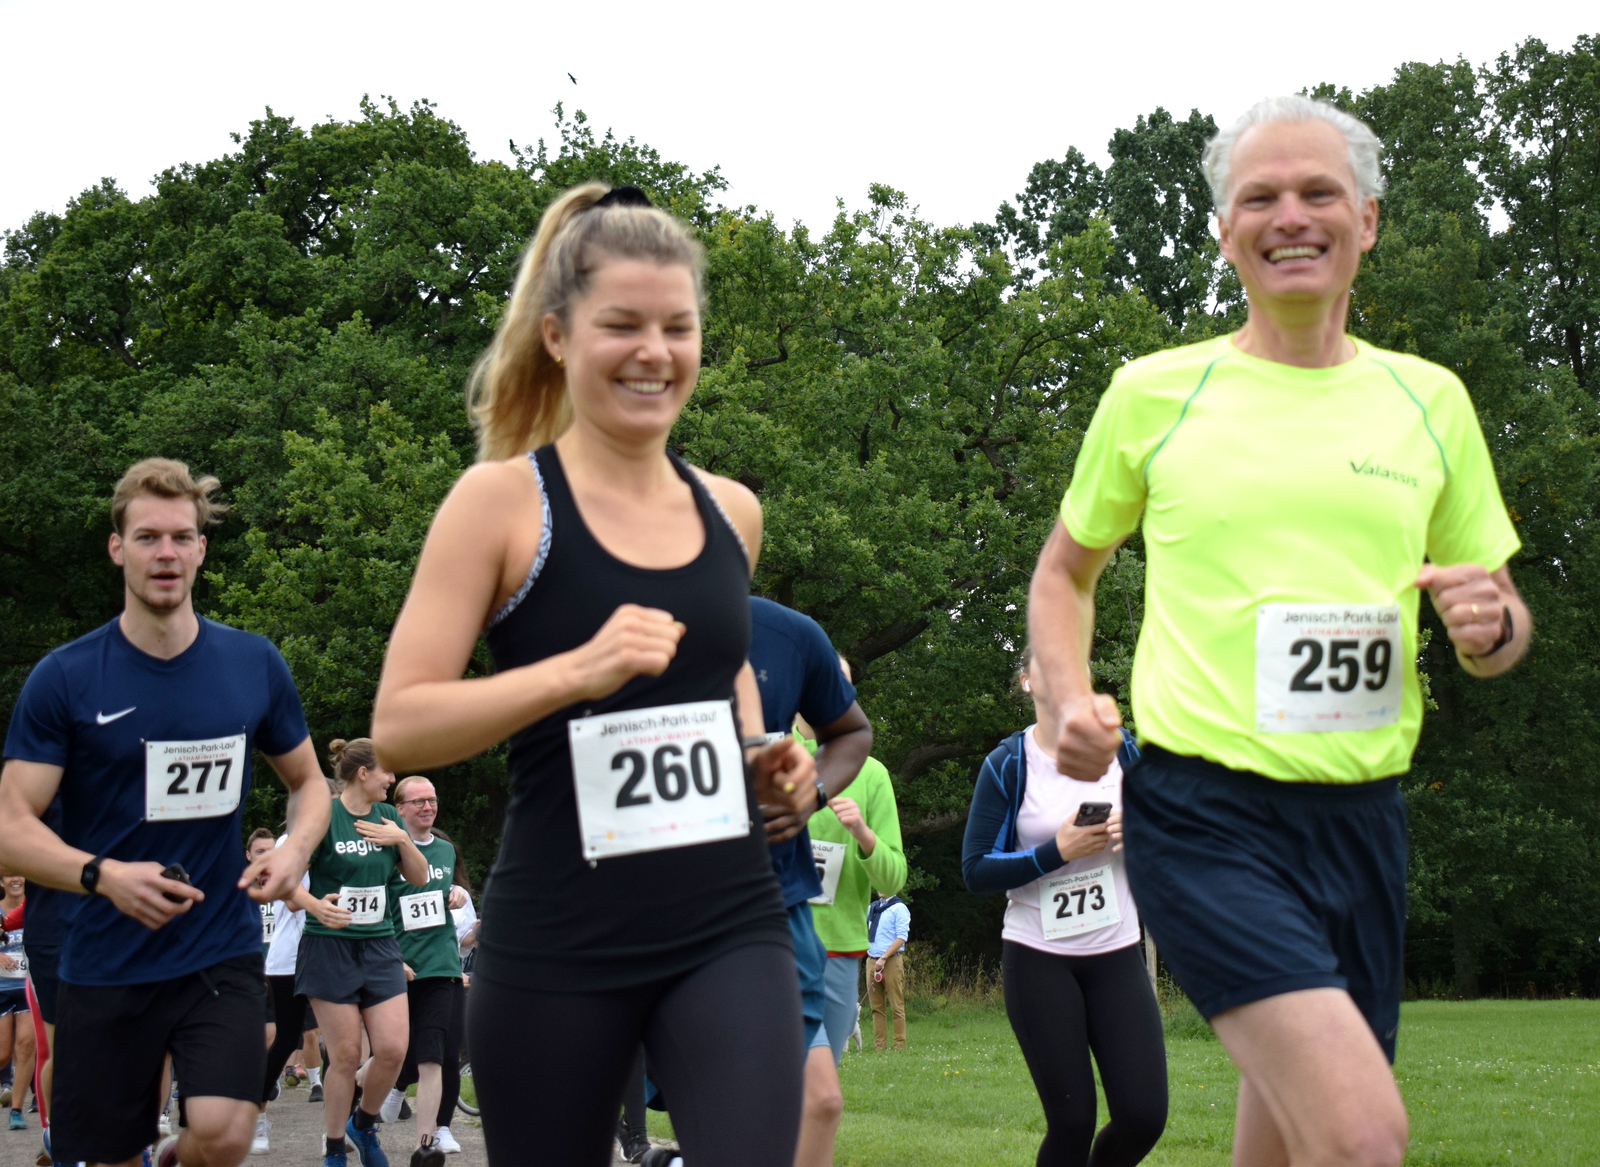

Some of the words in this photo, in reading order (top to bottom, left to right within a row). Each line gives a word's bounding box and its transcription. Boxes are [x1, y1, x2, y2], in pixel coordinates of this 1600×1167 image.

[1289, 638, 1392, 693] 259
[164, 741, 236, 754] Jenisch-Park-Lauf
[167, 757, 233, 795] 277
[611, 740, 720, 809] 260
[335, 836, 382, 856] eagle
[1049, 869, 1104, 888] Jenisch-Park-Lauf
[347, 896, 379, 913] 314
[410, 900, 438, 919] 311
[1053, 884, 1106, 920] 273
